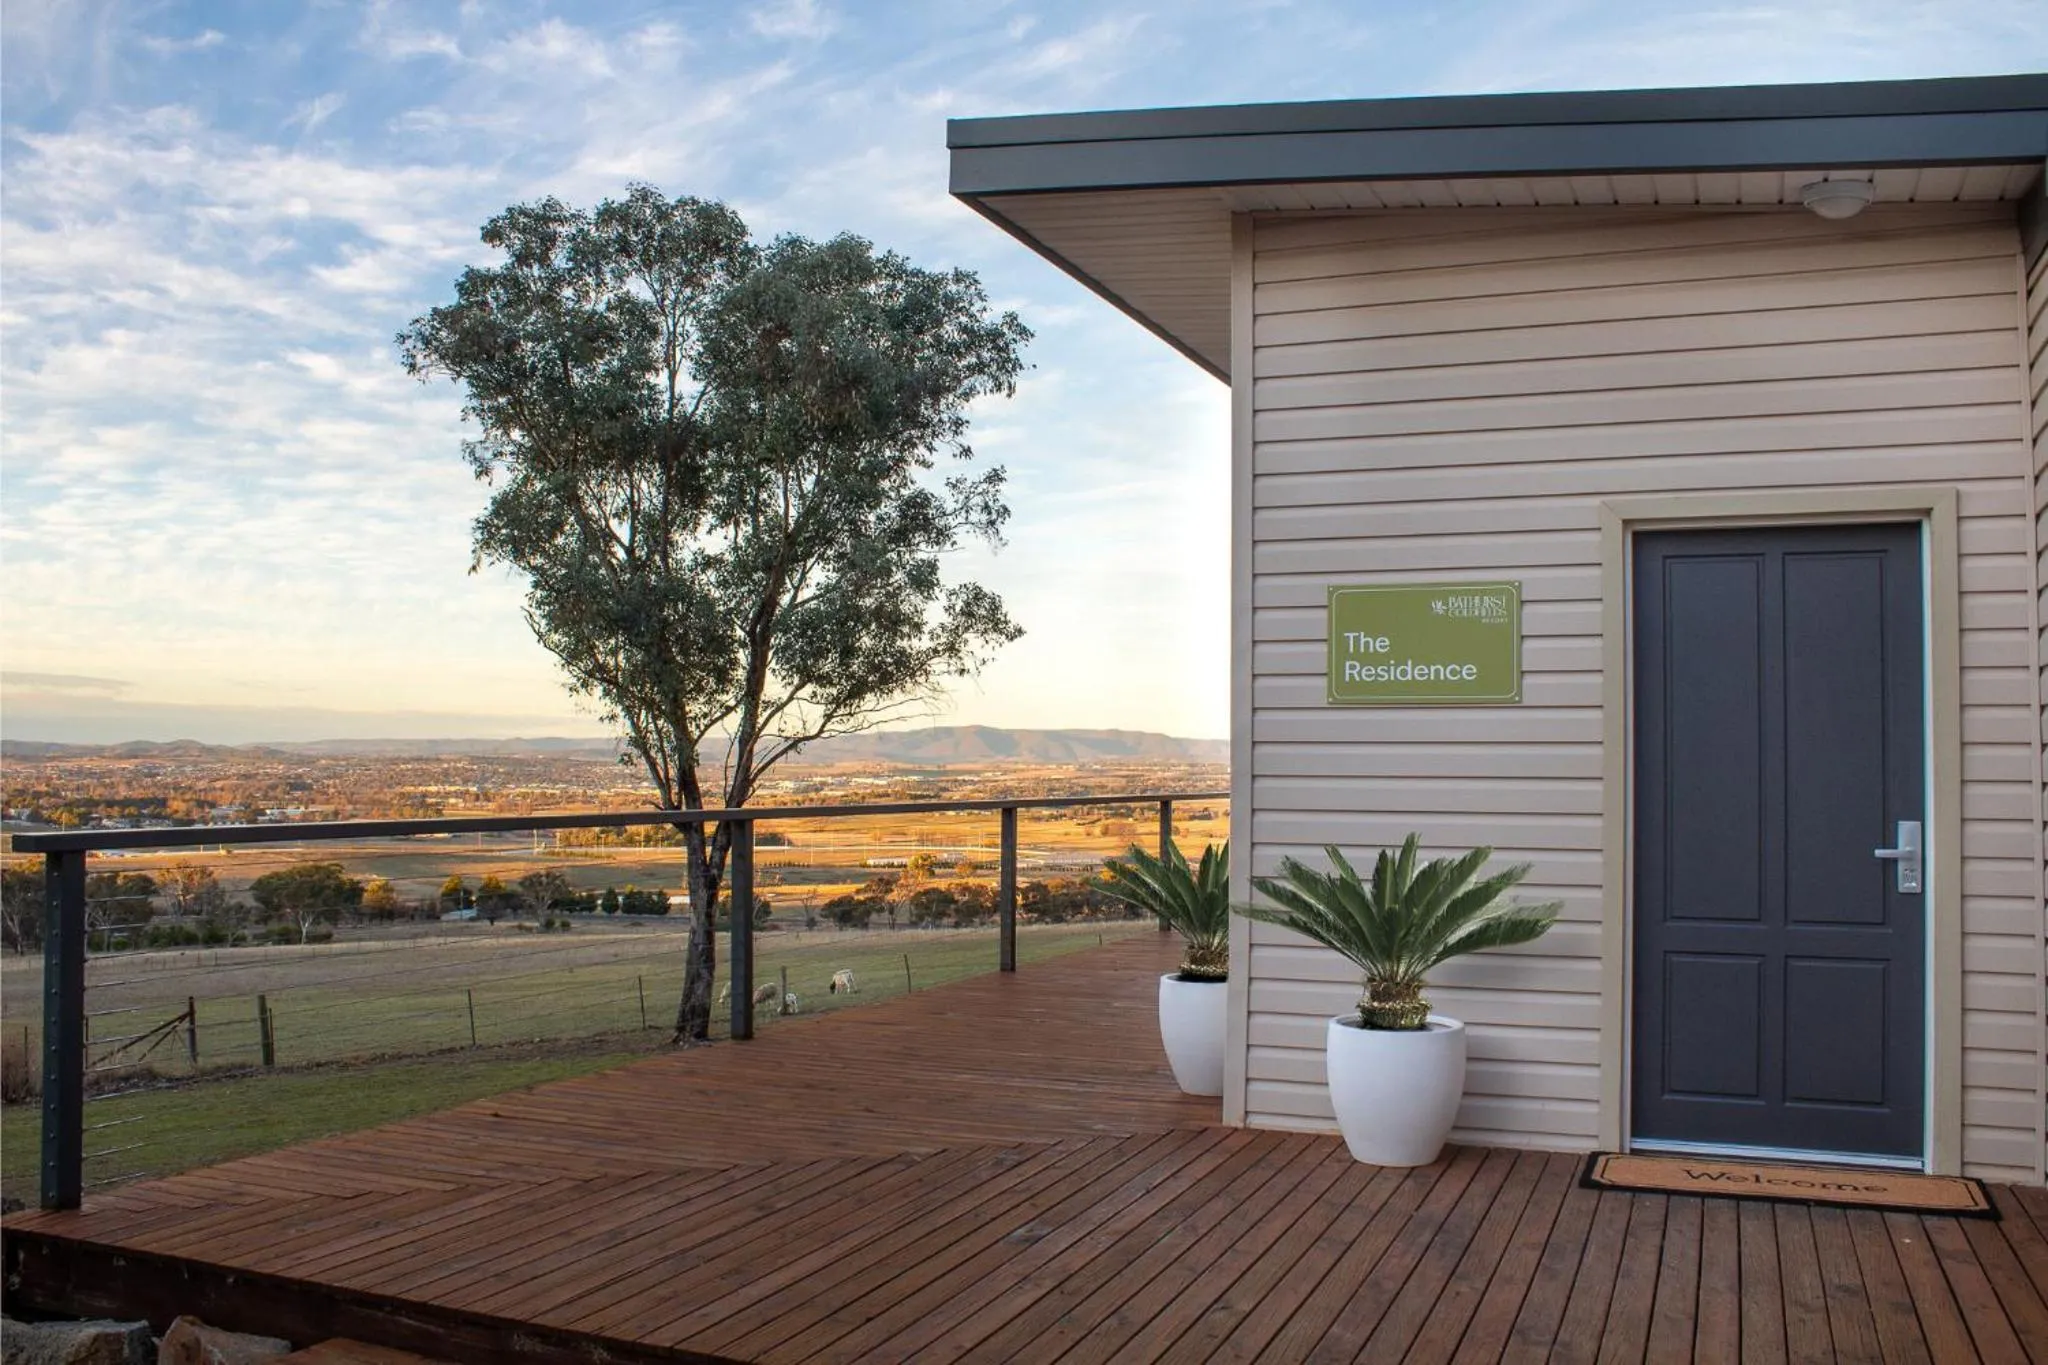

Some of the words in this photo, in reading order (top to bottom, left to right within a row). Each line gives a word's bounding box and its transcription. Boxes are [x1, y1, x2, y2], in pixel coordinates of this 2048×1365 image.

[1343, 632, 1390, 653] The
[1344, 659, 1477, 682] Residence
[1683, 1168, 1889, 1193] Welcome
